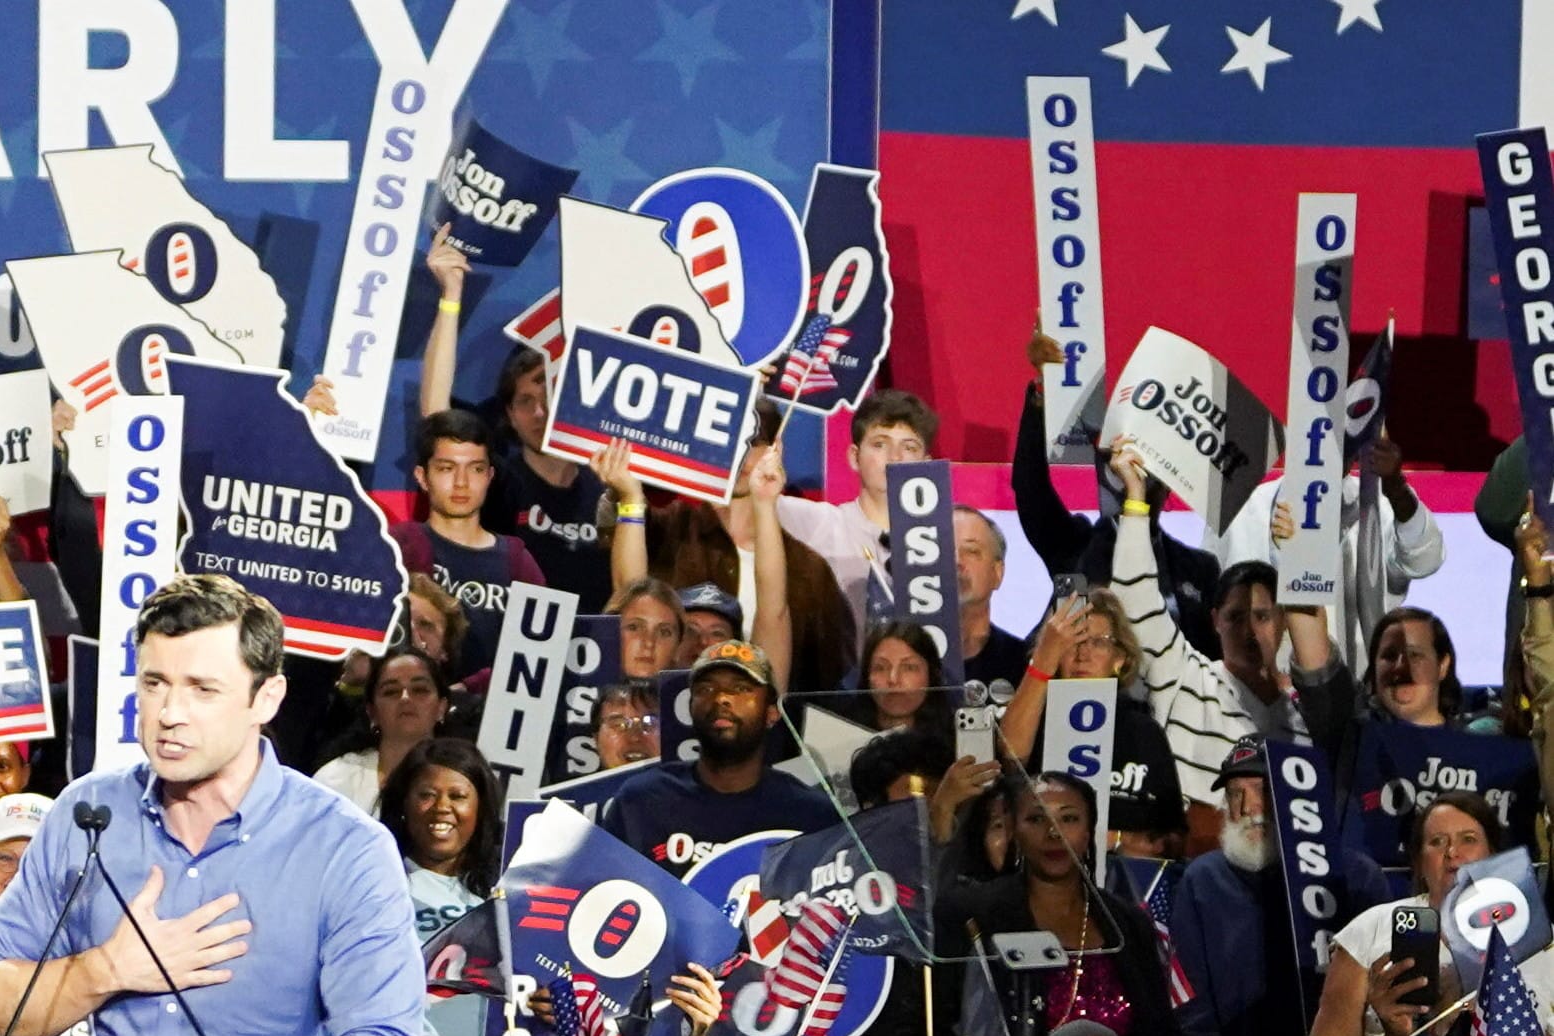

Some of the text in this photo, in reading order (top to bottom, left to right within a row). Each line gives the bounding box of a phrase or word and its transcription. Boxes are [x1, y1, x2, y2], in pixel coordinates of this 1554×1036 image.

[1497, 141, 1554, 397] GEORG
[577, 348, 739, 447] VOTE
[1173, 376, 1230, 432] Jon
[203, 475, 353, 531] UNITED
[228, 518, 338, 553] GEORGIA
[195, 552, 383, 597] TEXT UNITED TO 51015
[1108, 761, 1149, 790] off
[1417, 756, 1479, 791] Jon
